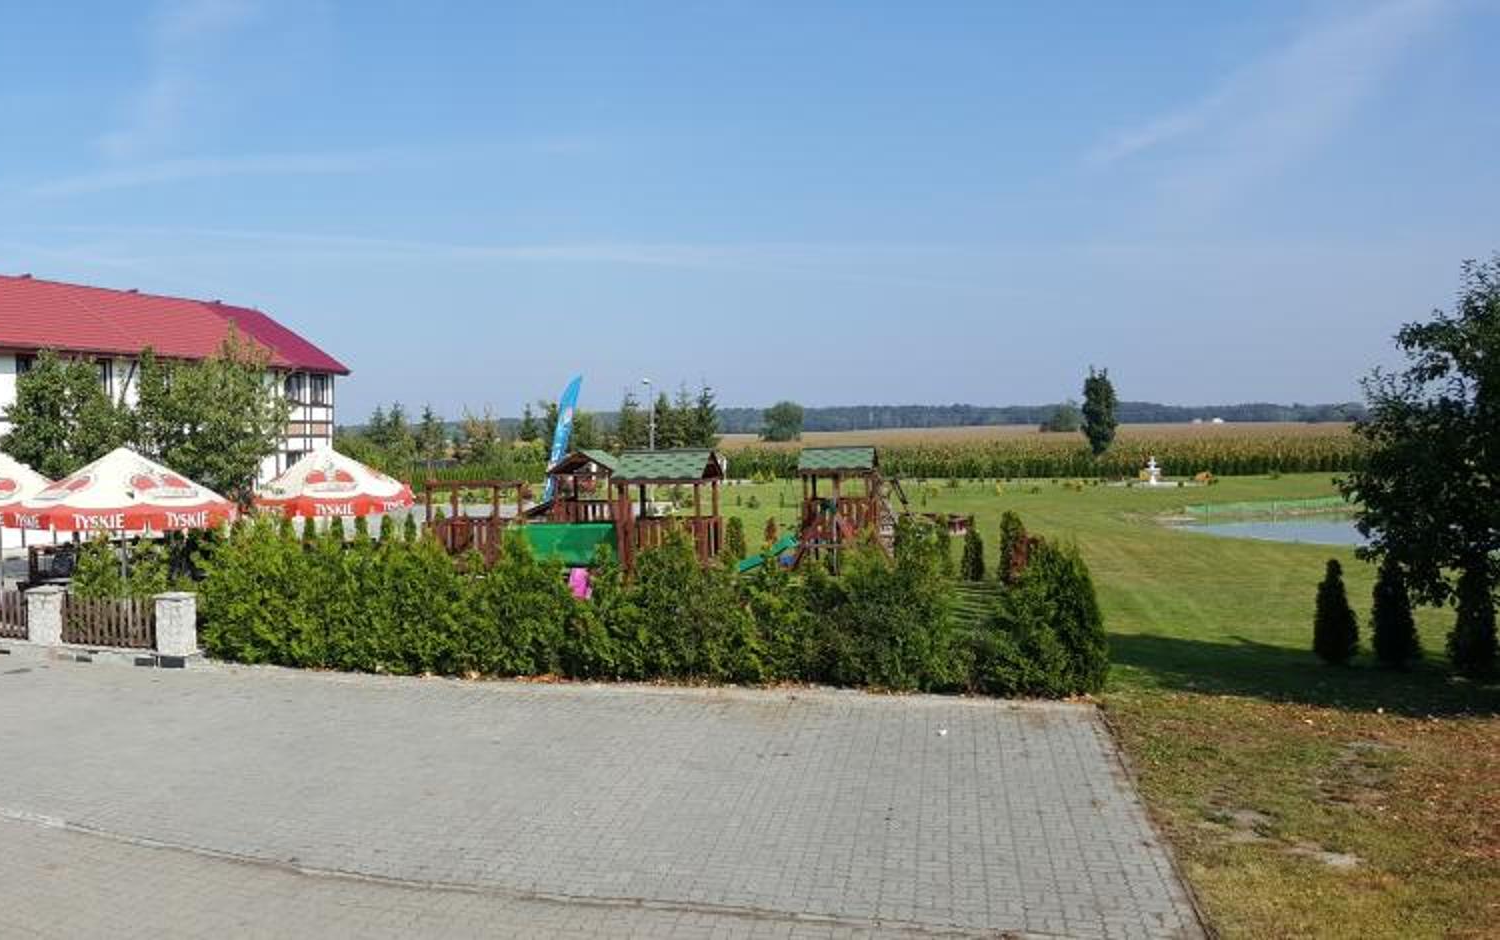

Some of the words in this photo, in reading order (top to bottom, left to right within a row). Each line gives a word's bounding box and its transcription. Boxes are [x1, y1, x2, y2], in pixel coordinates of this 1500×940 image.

[314, 503, 355, 515] TYSKIE
[72, 513, 125, 529] TYSKIE
[165, 511, 209, 527] TYSKIE
